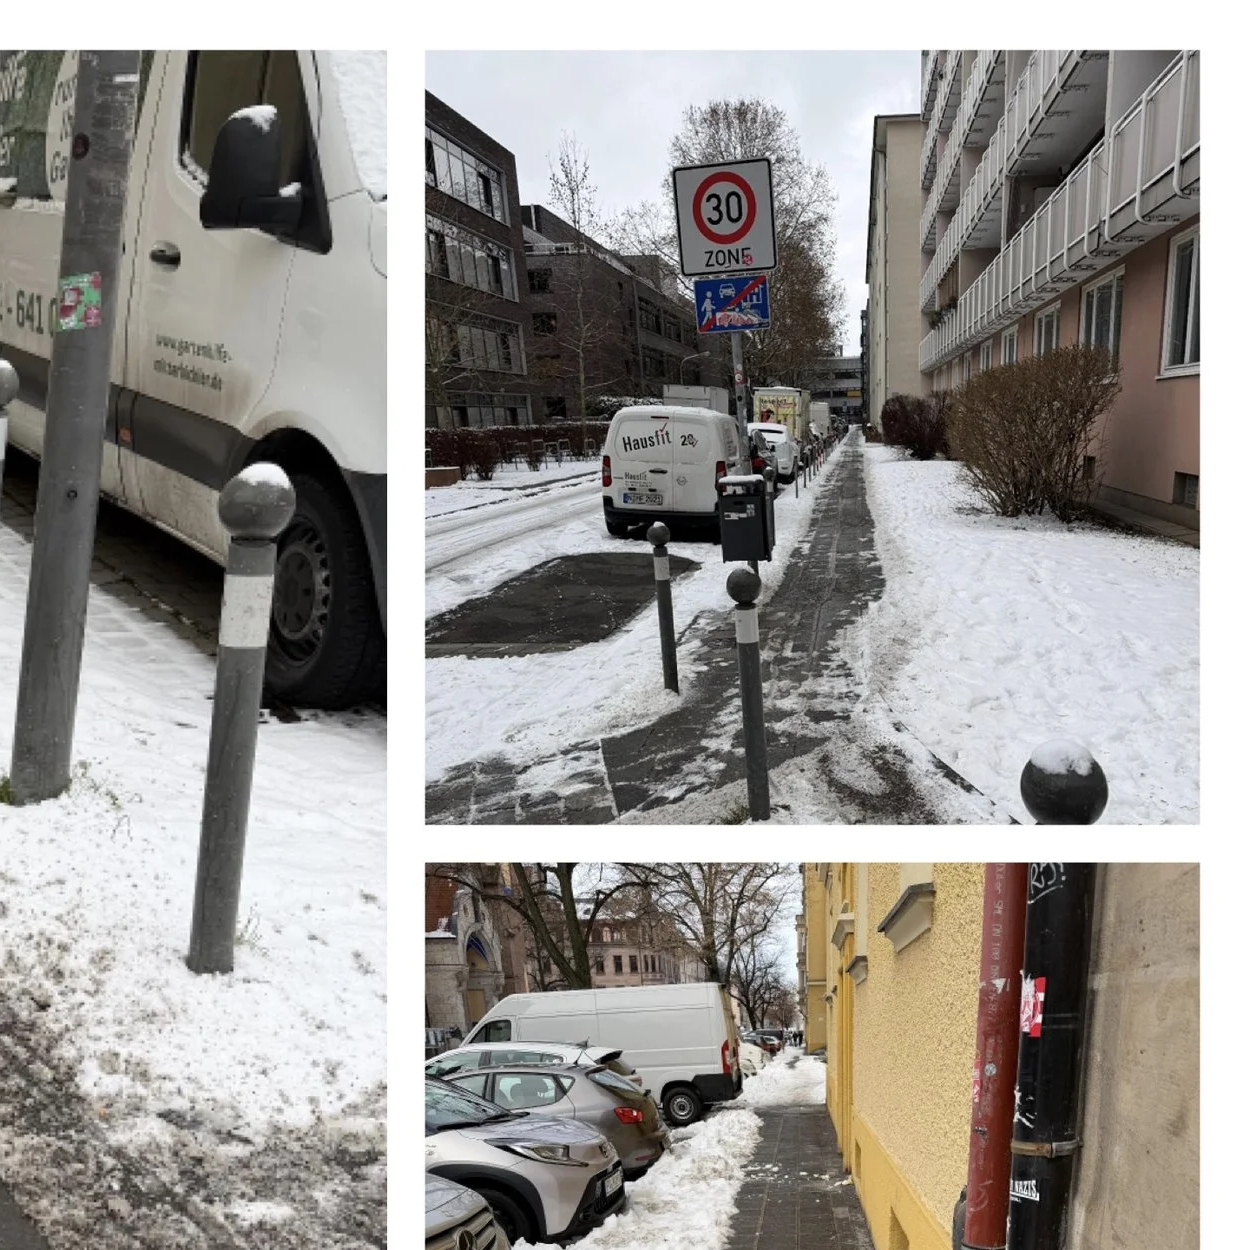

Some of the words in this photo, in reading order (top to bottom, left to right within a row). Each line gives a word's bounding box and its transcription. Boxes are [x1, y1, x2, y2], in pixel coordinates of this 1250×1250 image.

[705, 190, 743, 226] 30
[16, 290, 44, 335] 641
[622, 429, 672, 452] Hausfit
